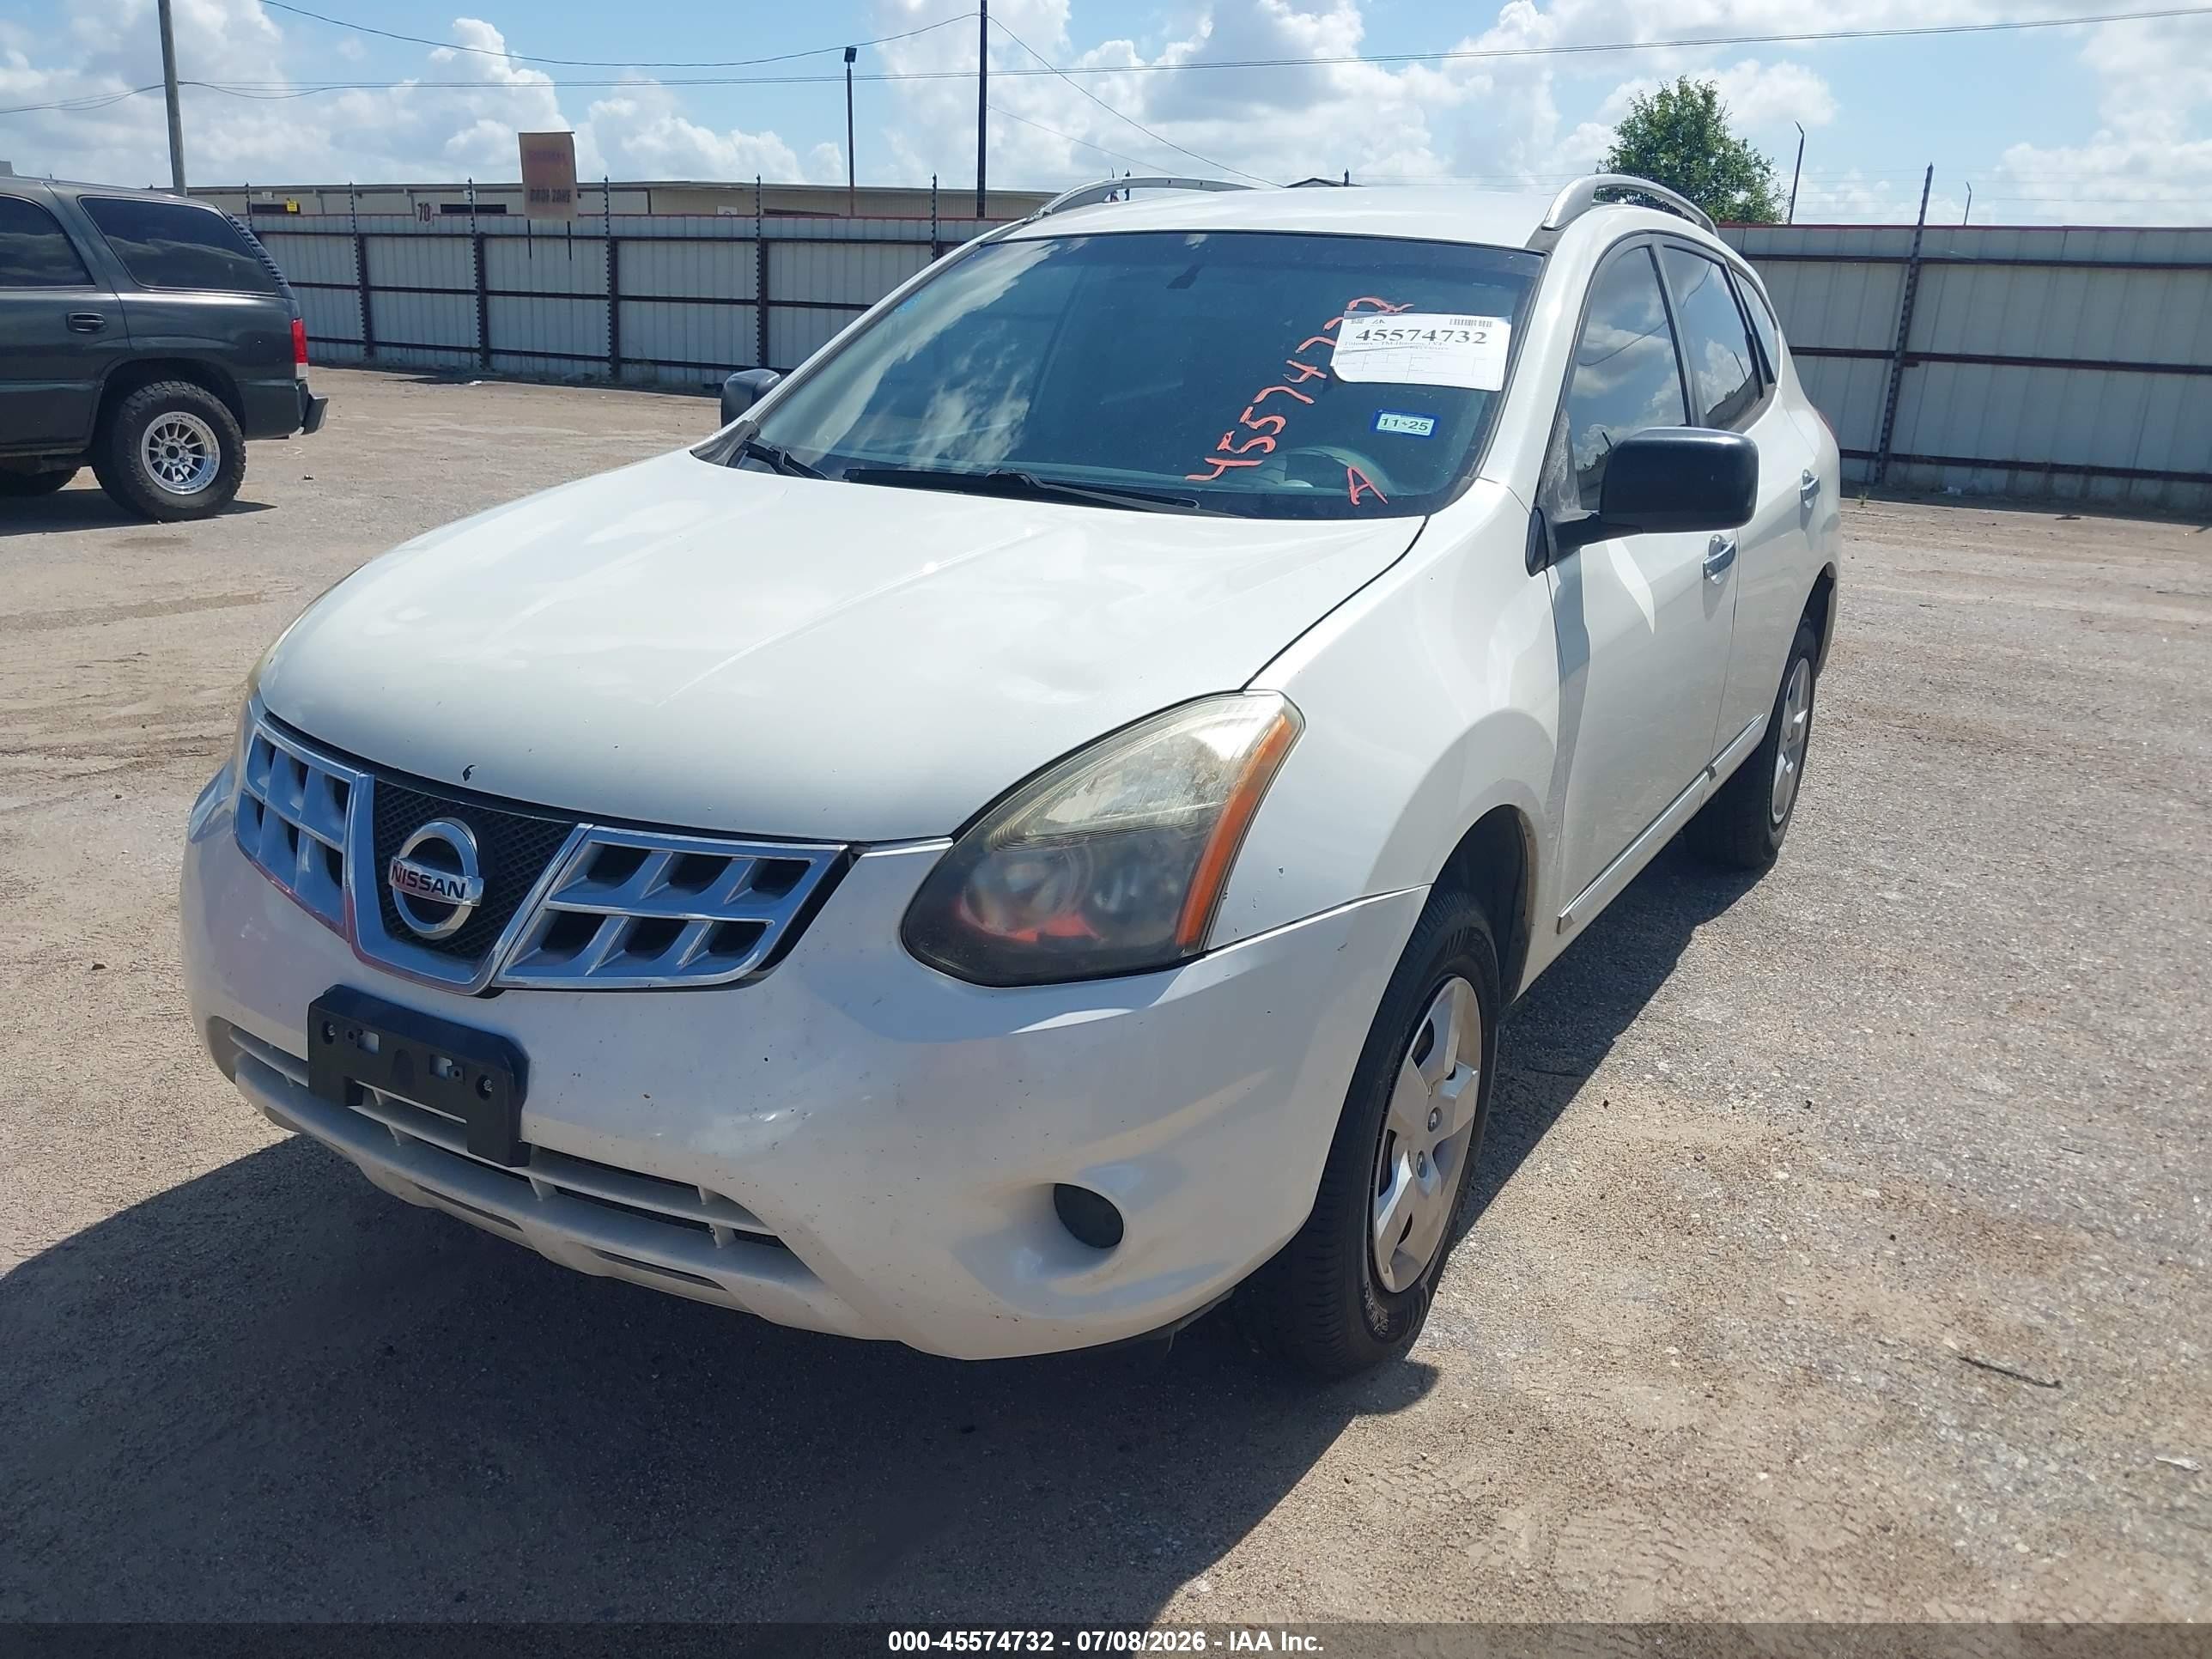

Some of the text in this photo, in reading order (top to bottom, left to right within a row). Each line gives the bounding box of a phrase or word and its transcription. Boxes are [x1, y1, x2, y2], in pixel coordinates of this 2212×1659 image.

[1355, 328, 1488, 345] 45574732
[1346, 466, 1389, 506] A
[391, 863, 466, 899] NISSAN
